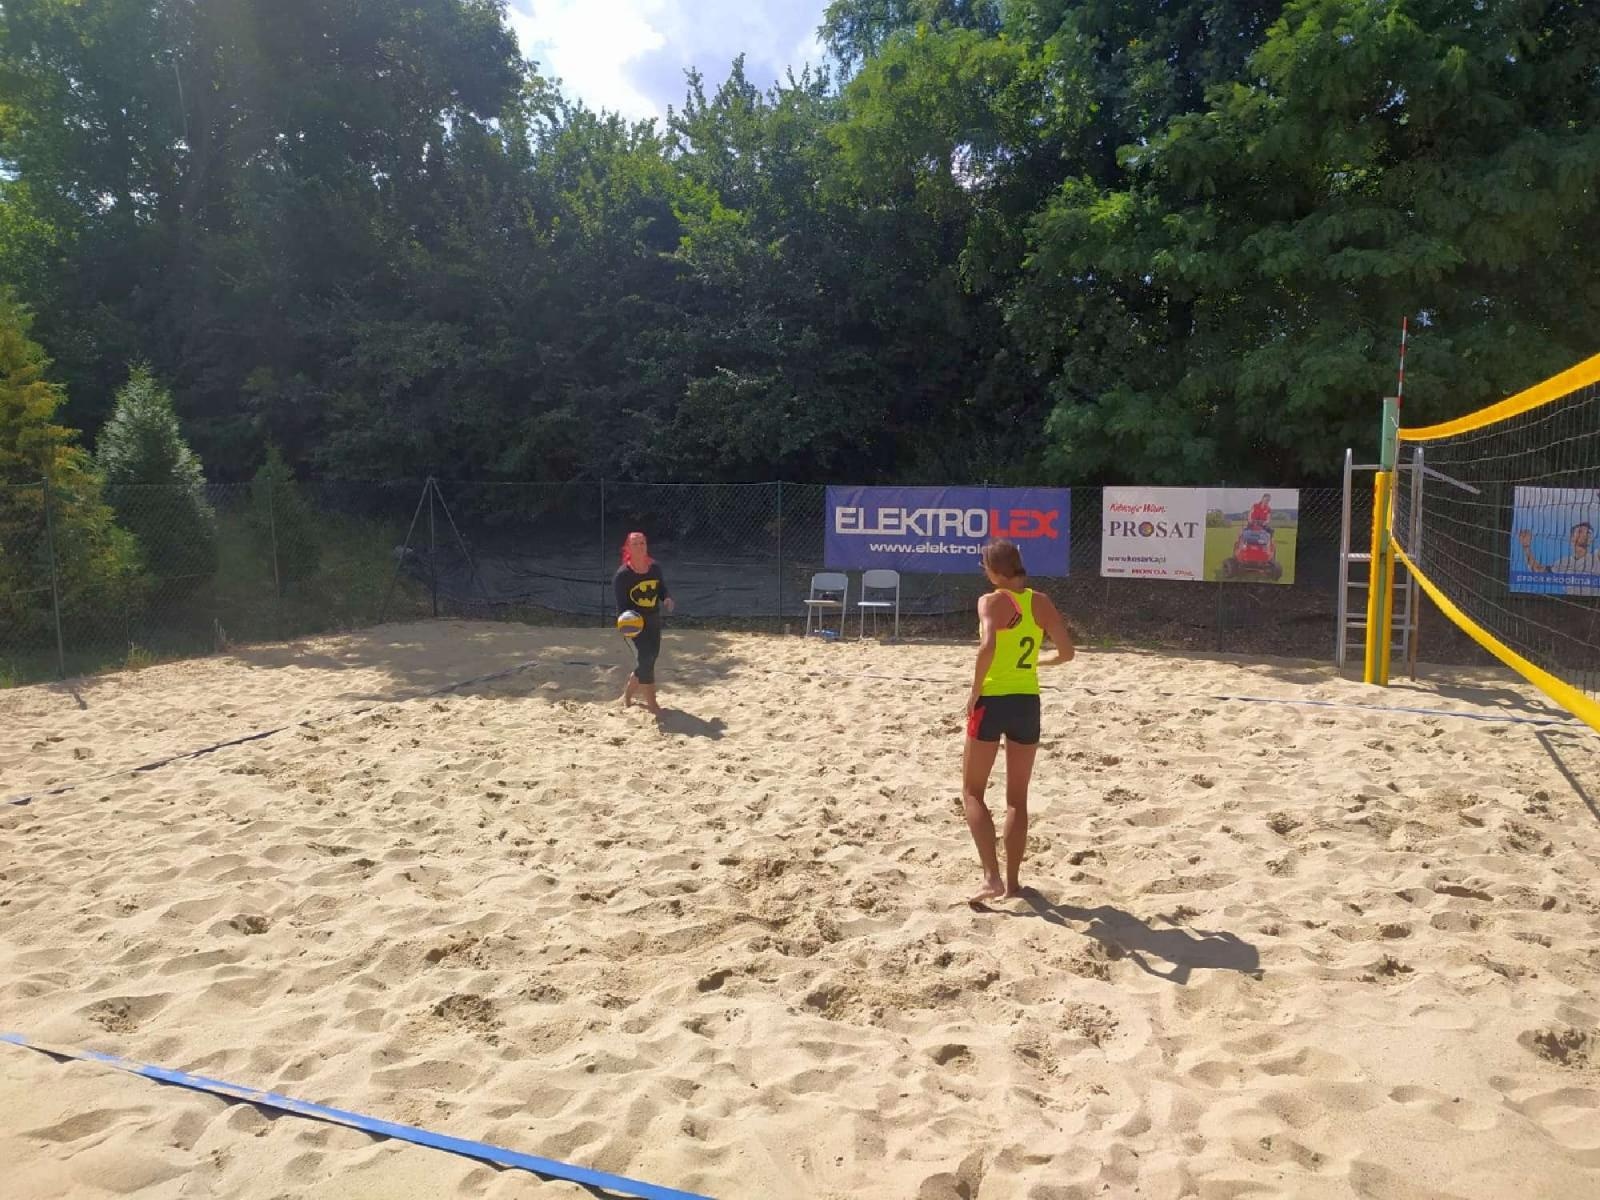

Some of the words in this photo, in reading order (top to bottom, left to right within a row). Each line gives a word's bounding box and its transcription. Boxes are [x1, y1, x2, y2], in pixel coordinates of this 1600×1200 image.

[835, 506, 1059, 539] ELEKTROLEX
[1109, 521, 1199, 538] PROSAT
[869, 542, 1021, 555] www.elektroll
[1015, 636, 1035, 669] 2
